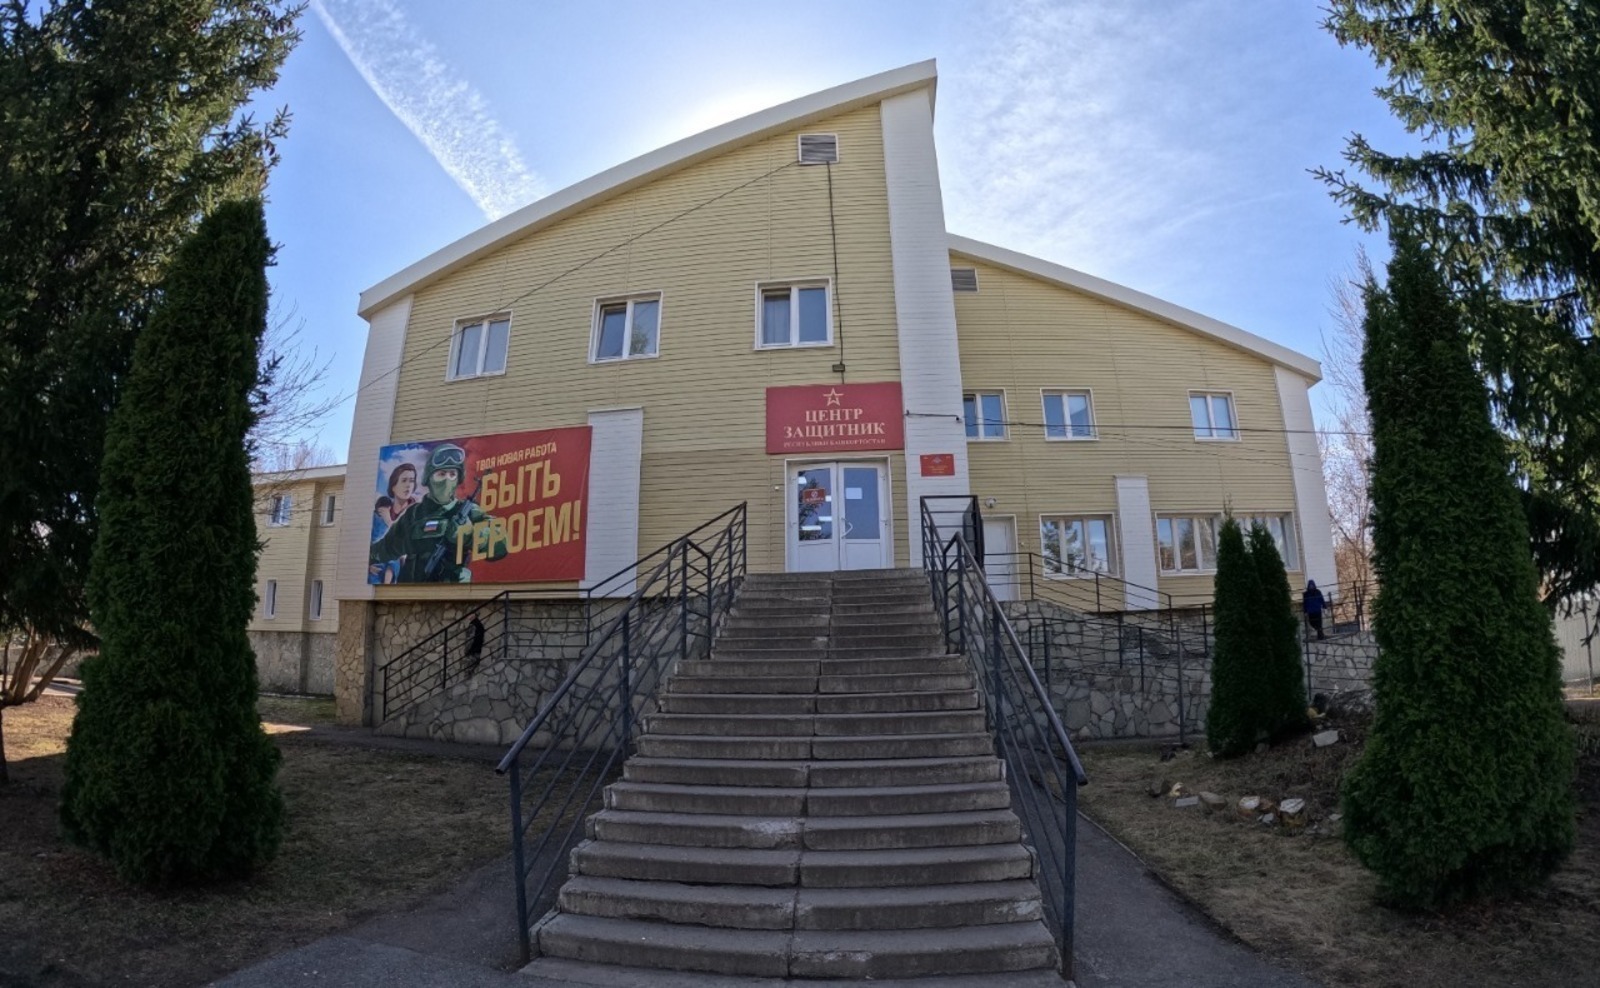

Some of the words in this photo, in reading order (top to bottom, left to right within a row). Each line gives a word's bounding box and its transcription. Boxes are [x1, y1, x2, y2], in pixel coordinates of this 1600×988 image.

[783, 423, 885, 439] ЗАЩИТНИК
[806, 408, 863, 423] ЦЕНТР
[476, 456, 496, 472] ТВОЯ
[497, 450, 524, 466] НОВАЯ
[524, 441, 557, 459] РАБОТА
[481, 459, 561, 512] БЫТЬ
[456, 500, 581, 565] ГЕРОЕМ!
